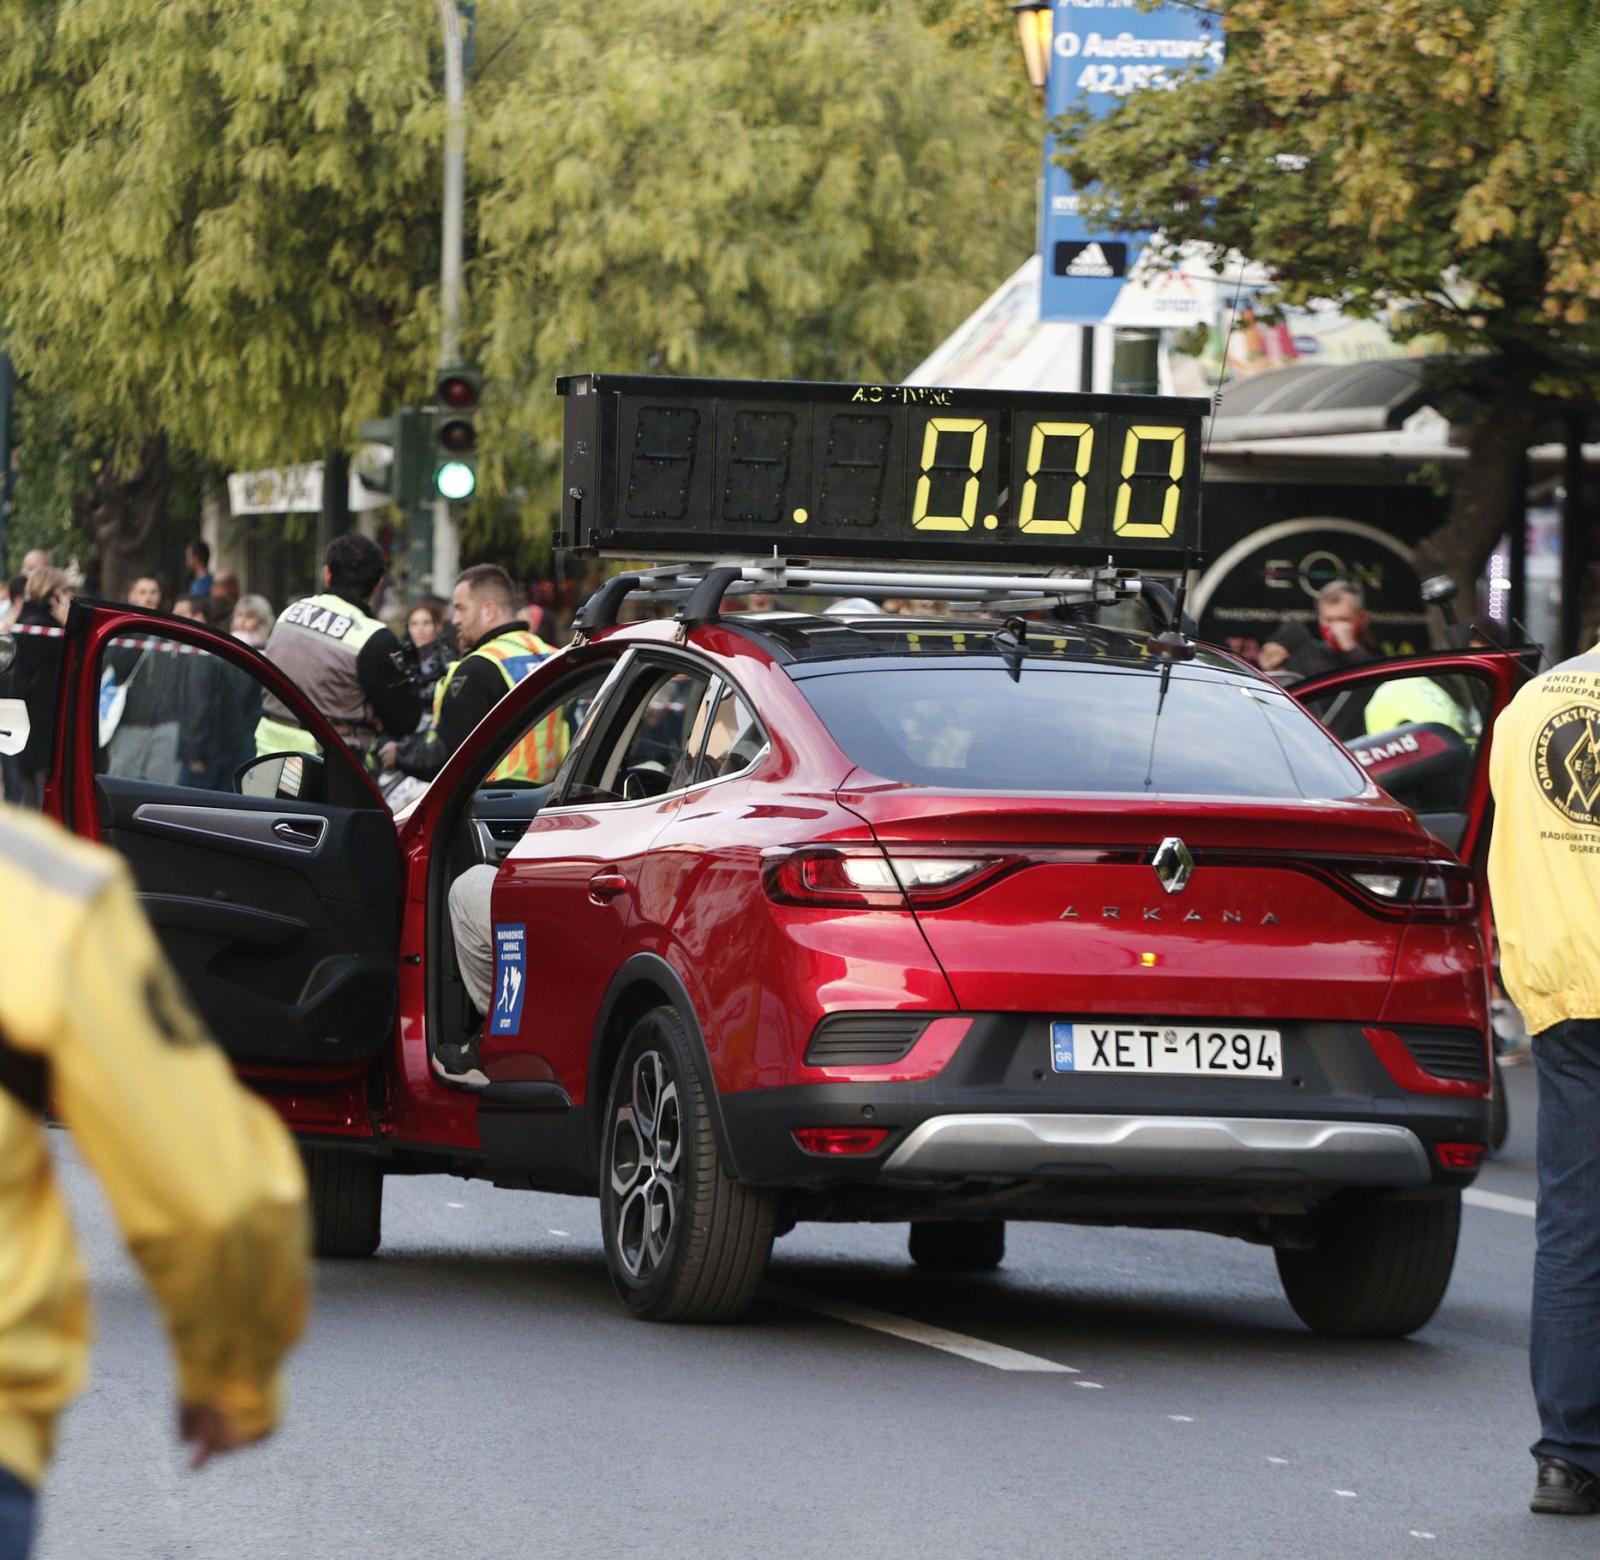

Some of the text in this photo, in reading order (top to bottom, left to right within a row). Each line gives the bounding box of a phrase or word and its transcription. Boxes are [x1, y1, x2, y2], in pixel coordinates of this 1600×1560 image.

[1545, 674, 1586, 685] ΕΝΩΣΗ
[1059, 905, 1280, 926] ARKANA
[1056, 1051, 1073, 1063] GR
[1090, 1029, 1275, 1071] XET-1294
